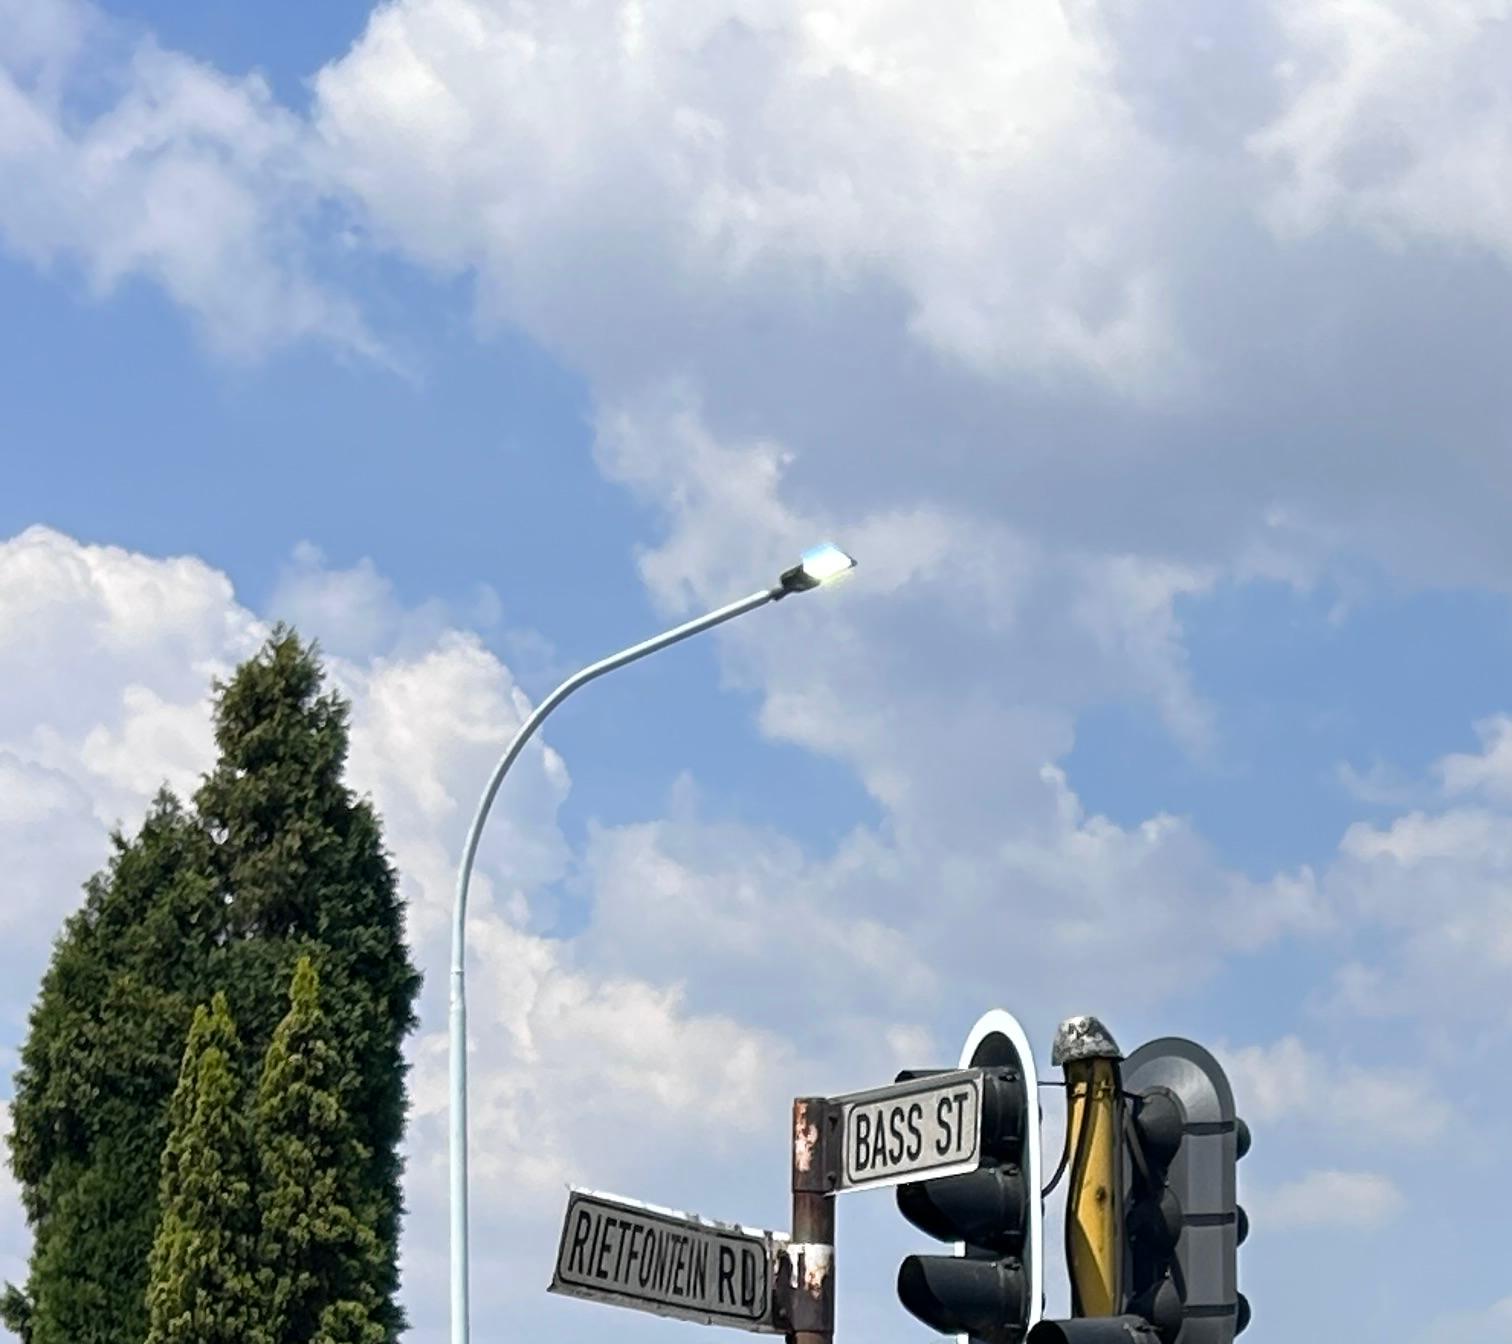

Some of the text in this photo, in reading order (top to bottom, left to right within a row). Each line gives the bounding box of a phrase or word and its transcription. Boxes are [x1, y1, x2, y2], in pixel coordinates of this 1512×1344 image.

[855, 1091, 969, 1172] BASS ST
[567, 1209, 758, 1308] RIETFONTEIN RD
